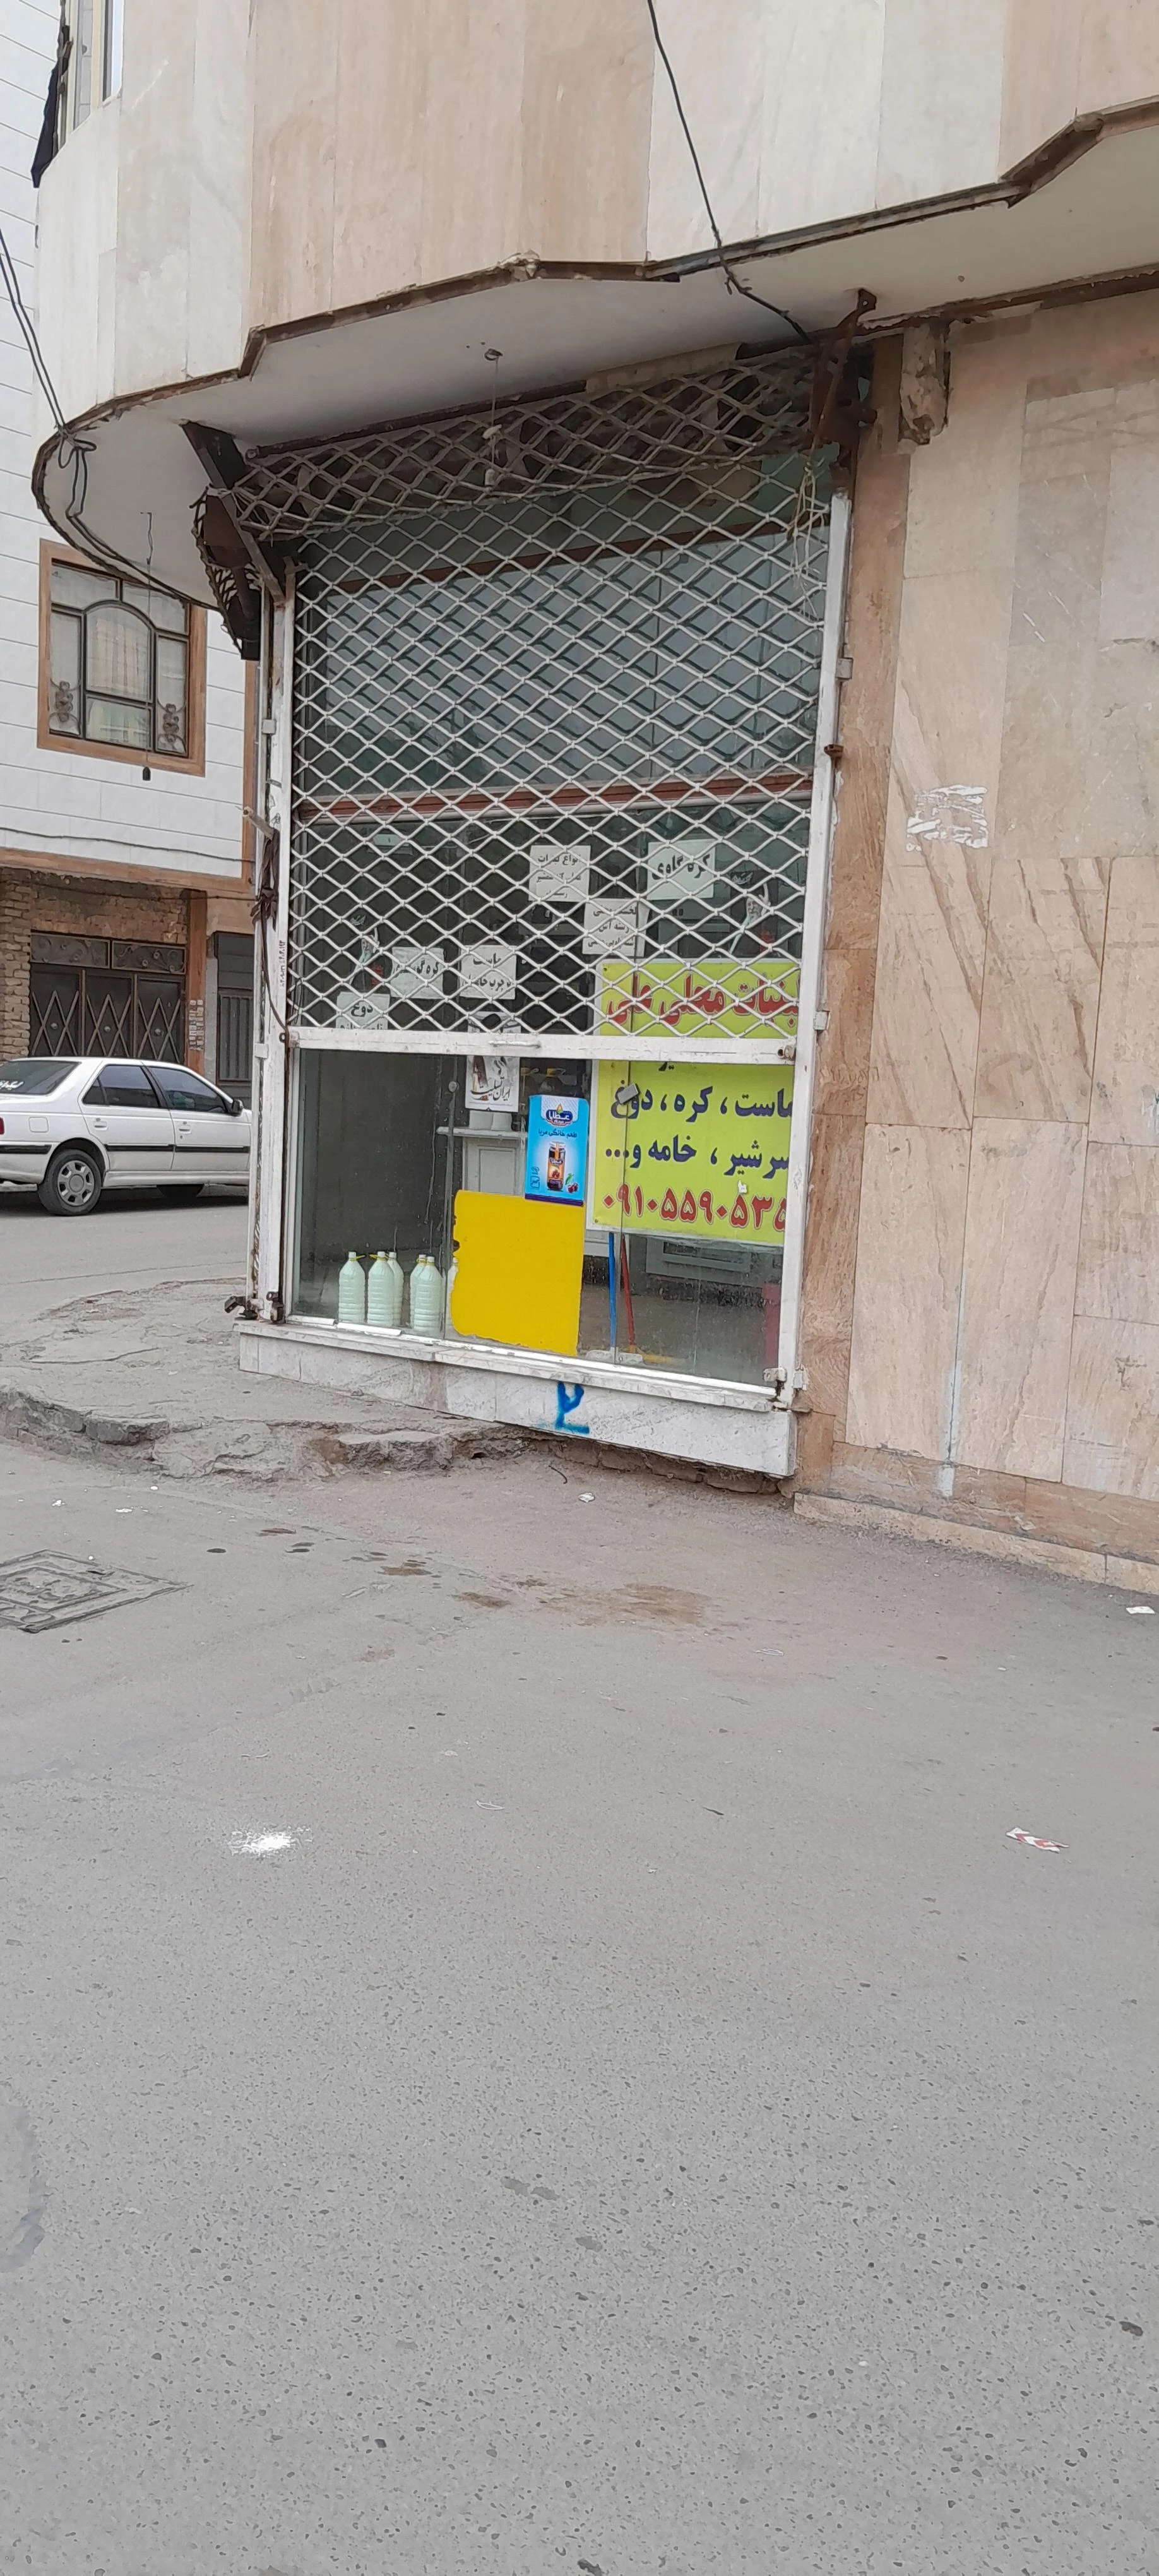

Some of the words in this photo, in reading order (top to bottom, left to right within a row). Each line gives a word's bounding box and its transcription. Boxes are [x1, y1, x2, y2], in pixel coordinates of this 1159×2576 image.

[651, 855, 684, 880] گاوی
[658, 973, 725, 1025] محلی
[732, 977, 800, 1026] بنیات
[610, 1079, 653, 1119] دوغ
[673, 1085, 713, 1123] کره
[735, 1088, 793, 1117] ماست
[648, 1134, 697, 1162] خامه
